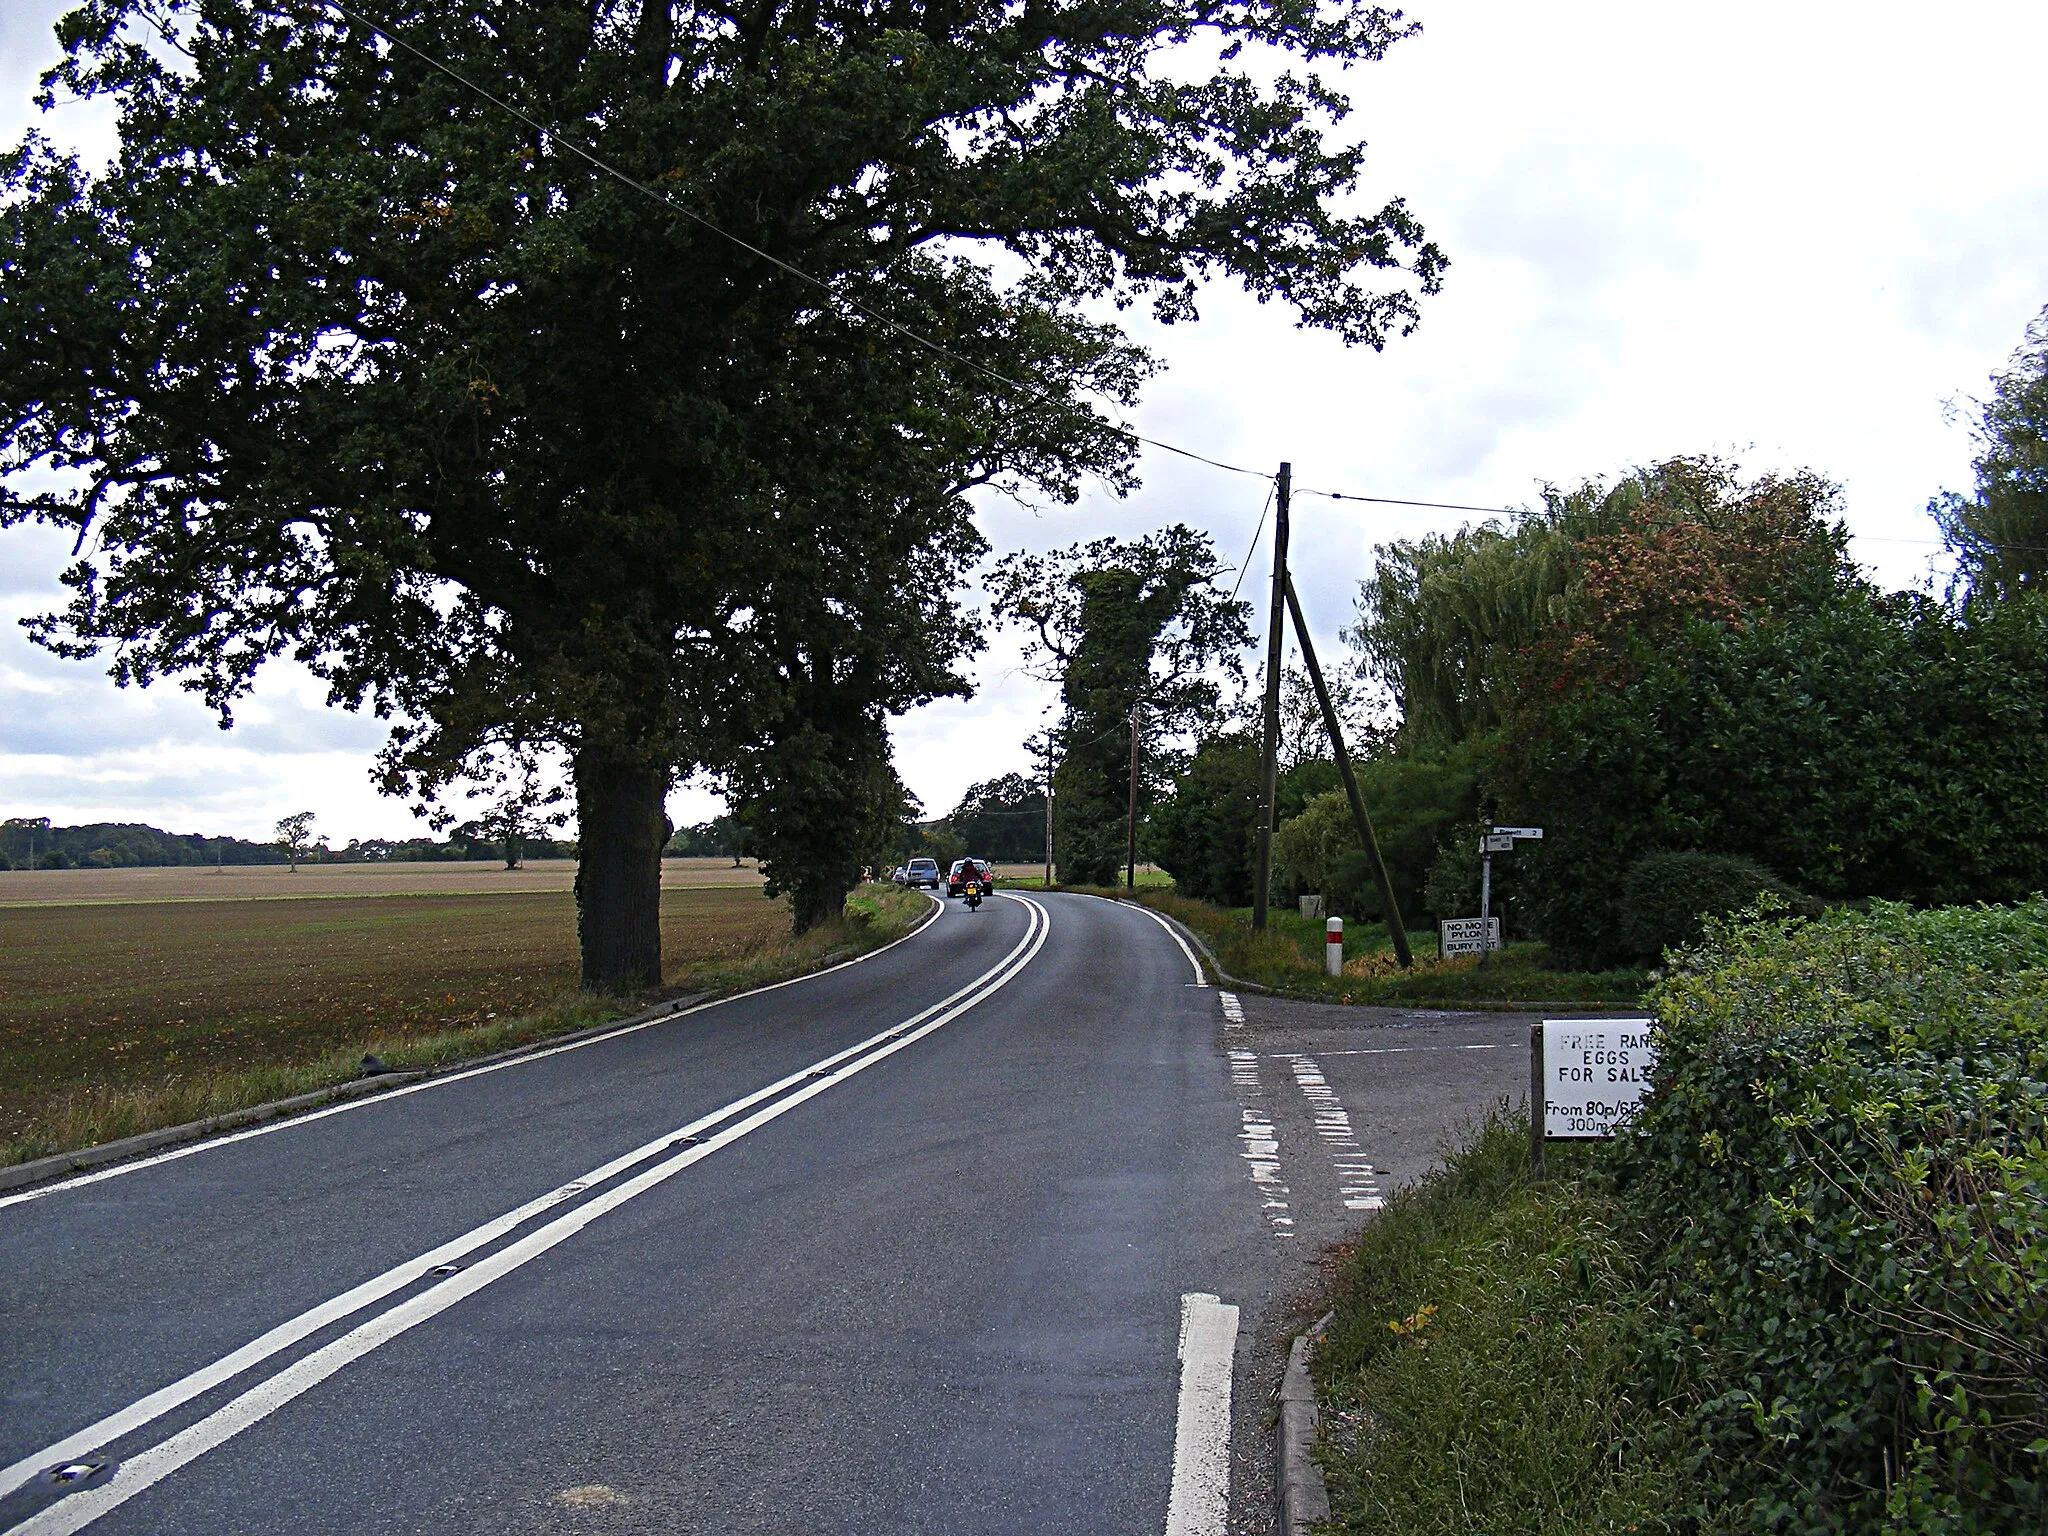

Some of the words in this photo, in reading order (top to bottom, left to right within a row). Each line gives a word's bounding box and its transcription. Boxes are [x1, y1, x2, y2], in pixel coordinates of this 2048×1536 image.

[1447, 923, 1462, 931] NO
[1465, 922, 1494, 930] MOE
[1447, 943, 1473, 951] BURY
[1560, 1034, 1606, 1050] FREE
[1583, 1051, 1629, 1065] EGGS
[1559, 1067, 1593, 1082] FOR
[1545, 1101, 1582, 1116] From
